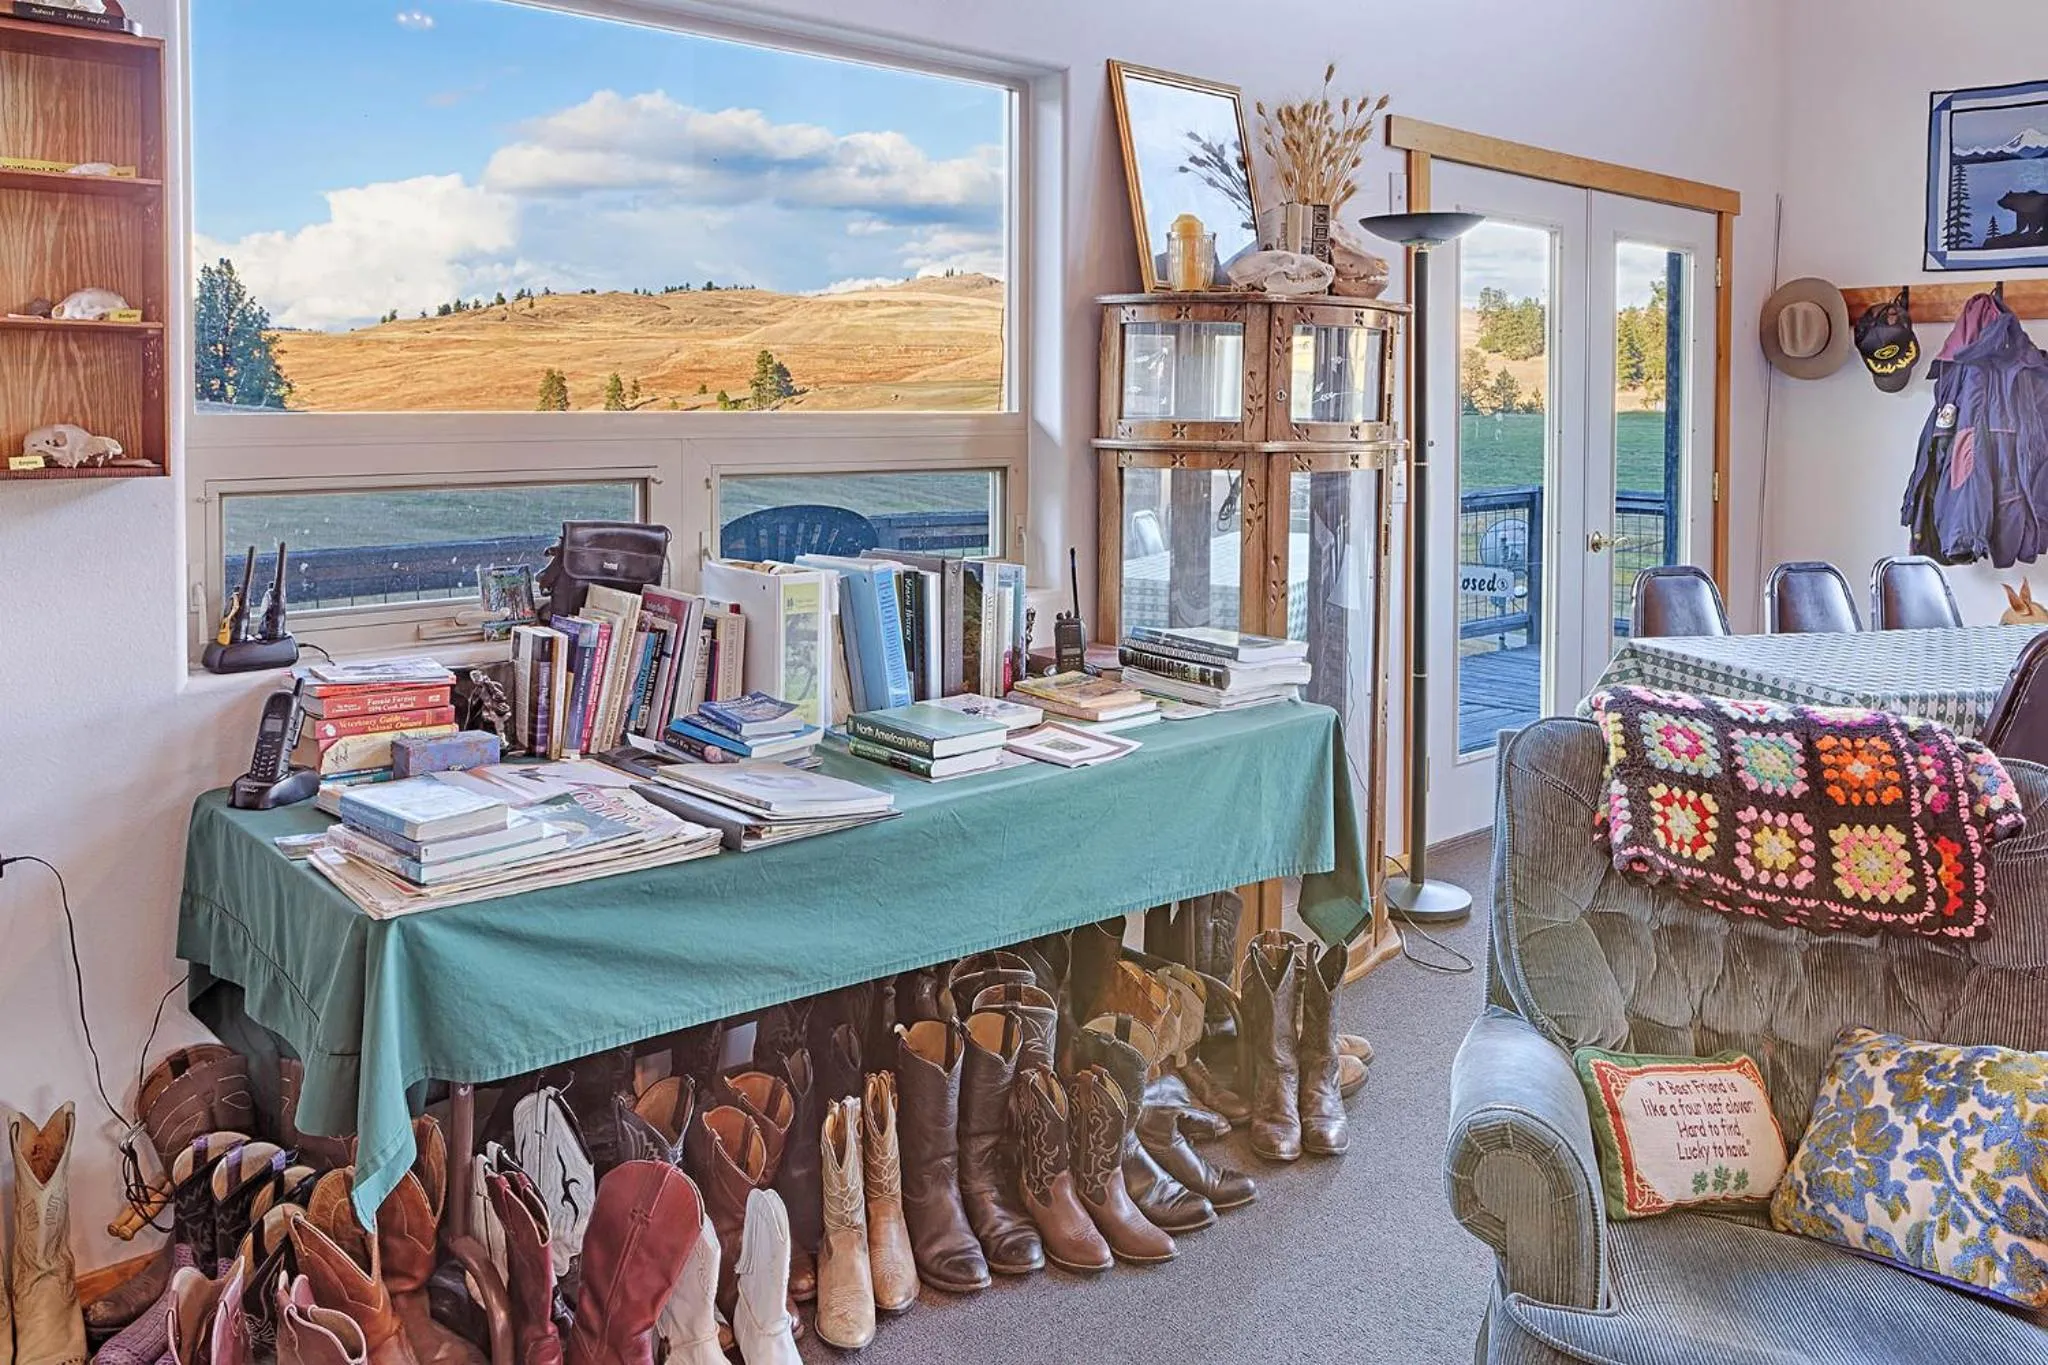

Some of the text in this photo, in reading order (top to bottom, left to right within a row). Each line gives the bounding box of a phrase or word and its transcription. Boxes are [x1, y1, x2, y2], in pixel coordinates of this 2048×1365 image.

[1462, 572, 1497, 592] osed
[856, 722, 875, 738] North
[873, 725, 906, 748] American
[1669, 1081, 1692, 1096] Best
[1693, 1078, 1726, 1094] Friend
[1727, 1077, 1738, 1093] is
[1641, 1099, 1667, 1117] like
[1669, 1104, 1679, 1116] a
[1679, 1100, 1701, 1116] four
[1703, 1100, 1724, 1115] leaf
[1677, 1120, 1707, 1138] Hard
[1708, 1120, 1720, 1138] to
[1676, 1143, 1710, 1165] Lucky
[1712, 1142, 1724, 1158] to
